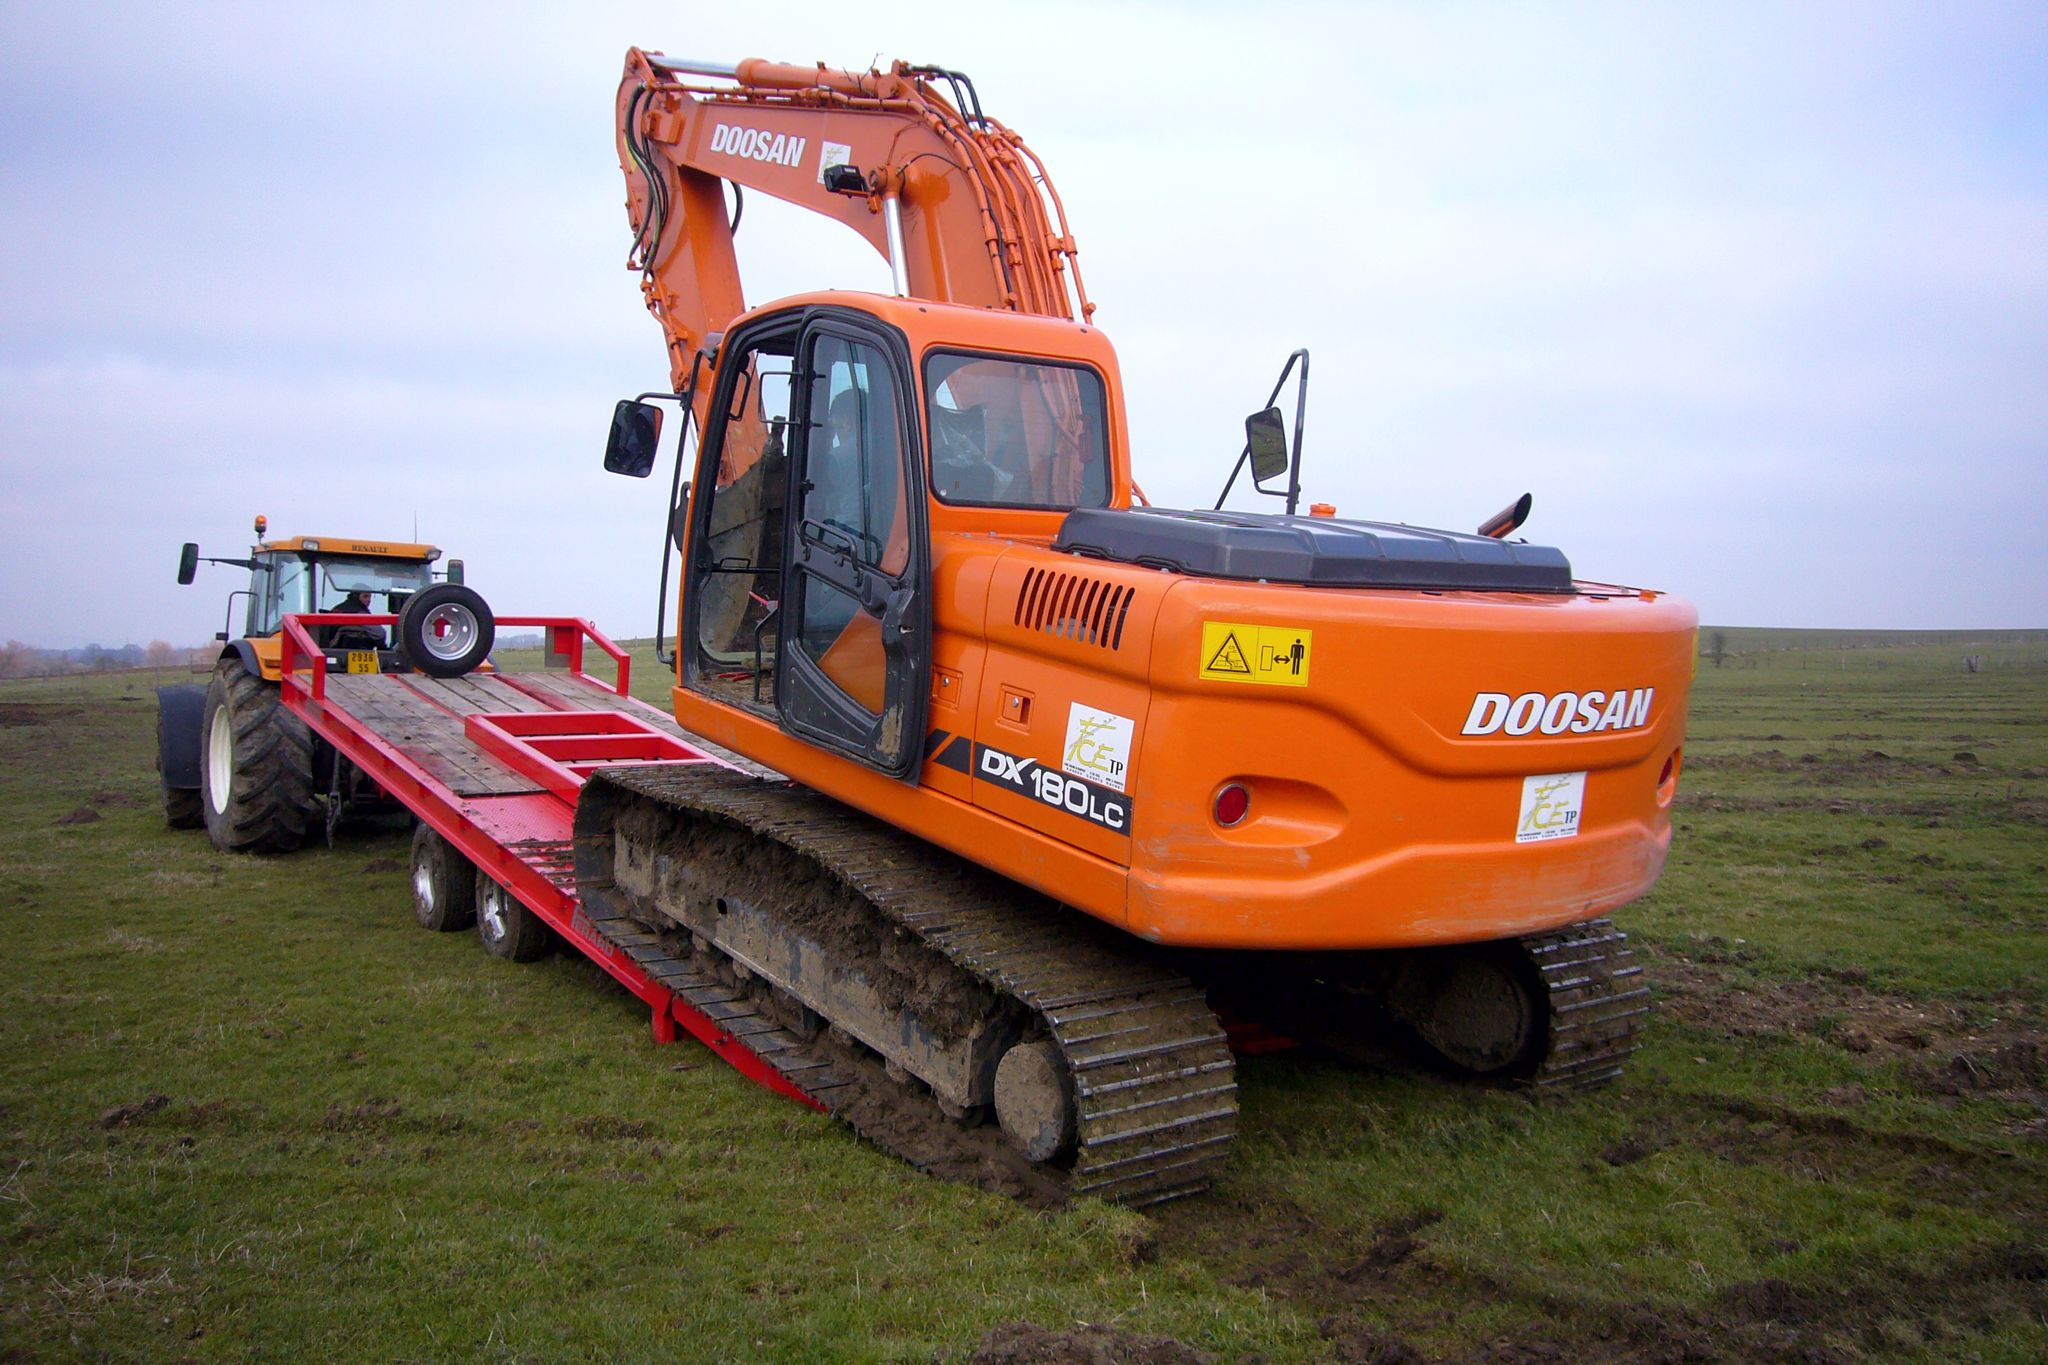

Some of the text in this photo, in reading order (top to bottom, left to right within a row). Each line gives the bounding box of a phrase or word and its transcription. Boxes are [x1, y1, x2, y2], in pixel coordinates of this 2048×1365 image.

[711, 123, 806, 168] DOOSAN
[351, 544, 389, 553] RENAULT
[1460, 687, 1655, 737] DOOSAN
